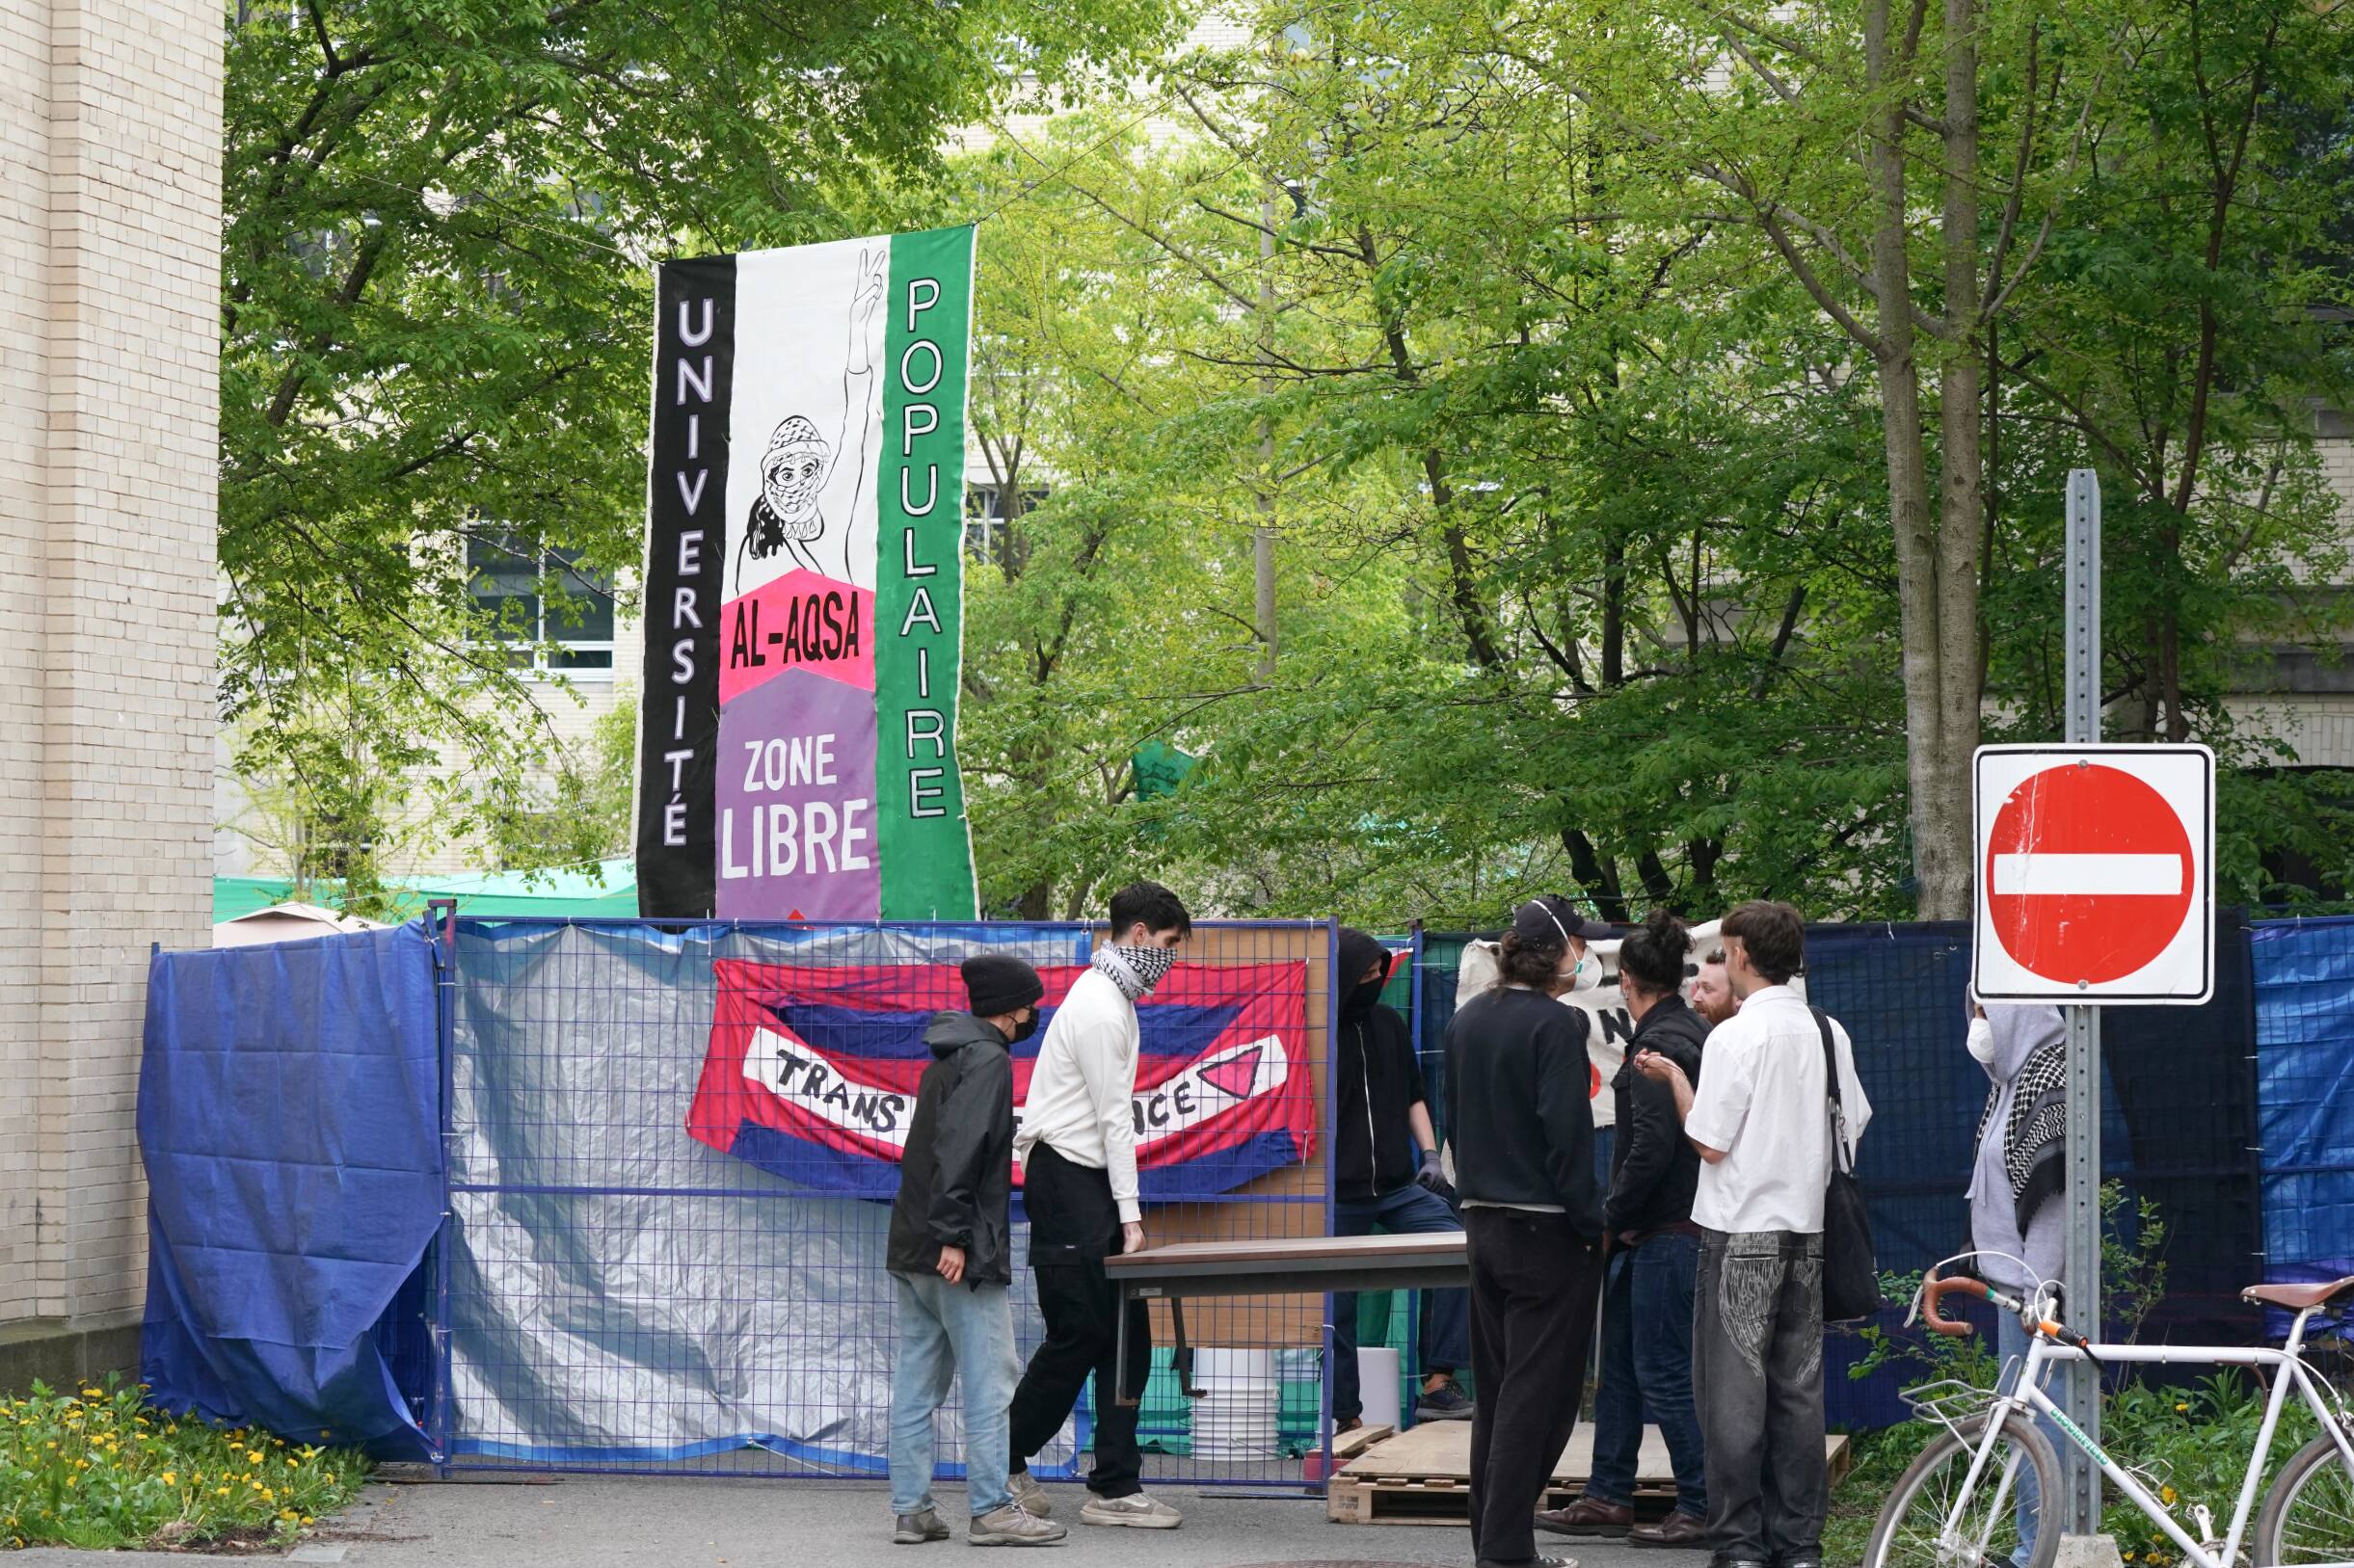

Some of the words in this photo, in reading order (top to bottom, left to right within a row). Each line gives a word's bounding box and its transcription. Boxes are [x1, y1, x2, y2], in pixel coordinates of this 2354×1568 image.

[664, 298, 713, 846] UNIVERSITÉ
[898, 278, 947, 819] POPULAIRE
[730, 591, 860, 670] AL-AQSA
[743, 733, 838, 792] ZONE
[721, 798, 870, 880] LIBRE
[775, 1049, 905, 1133] TRANS
